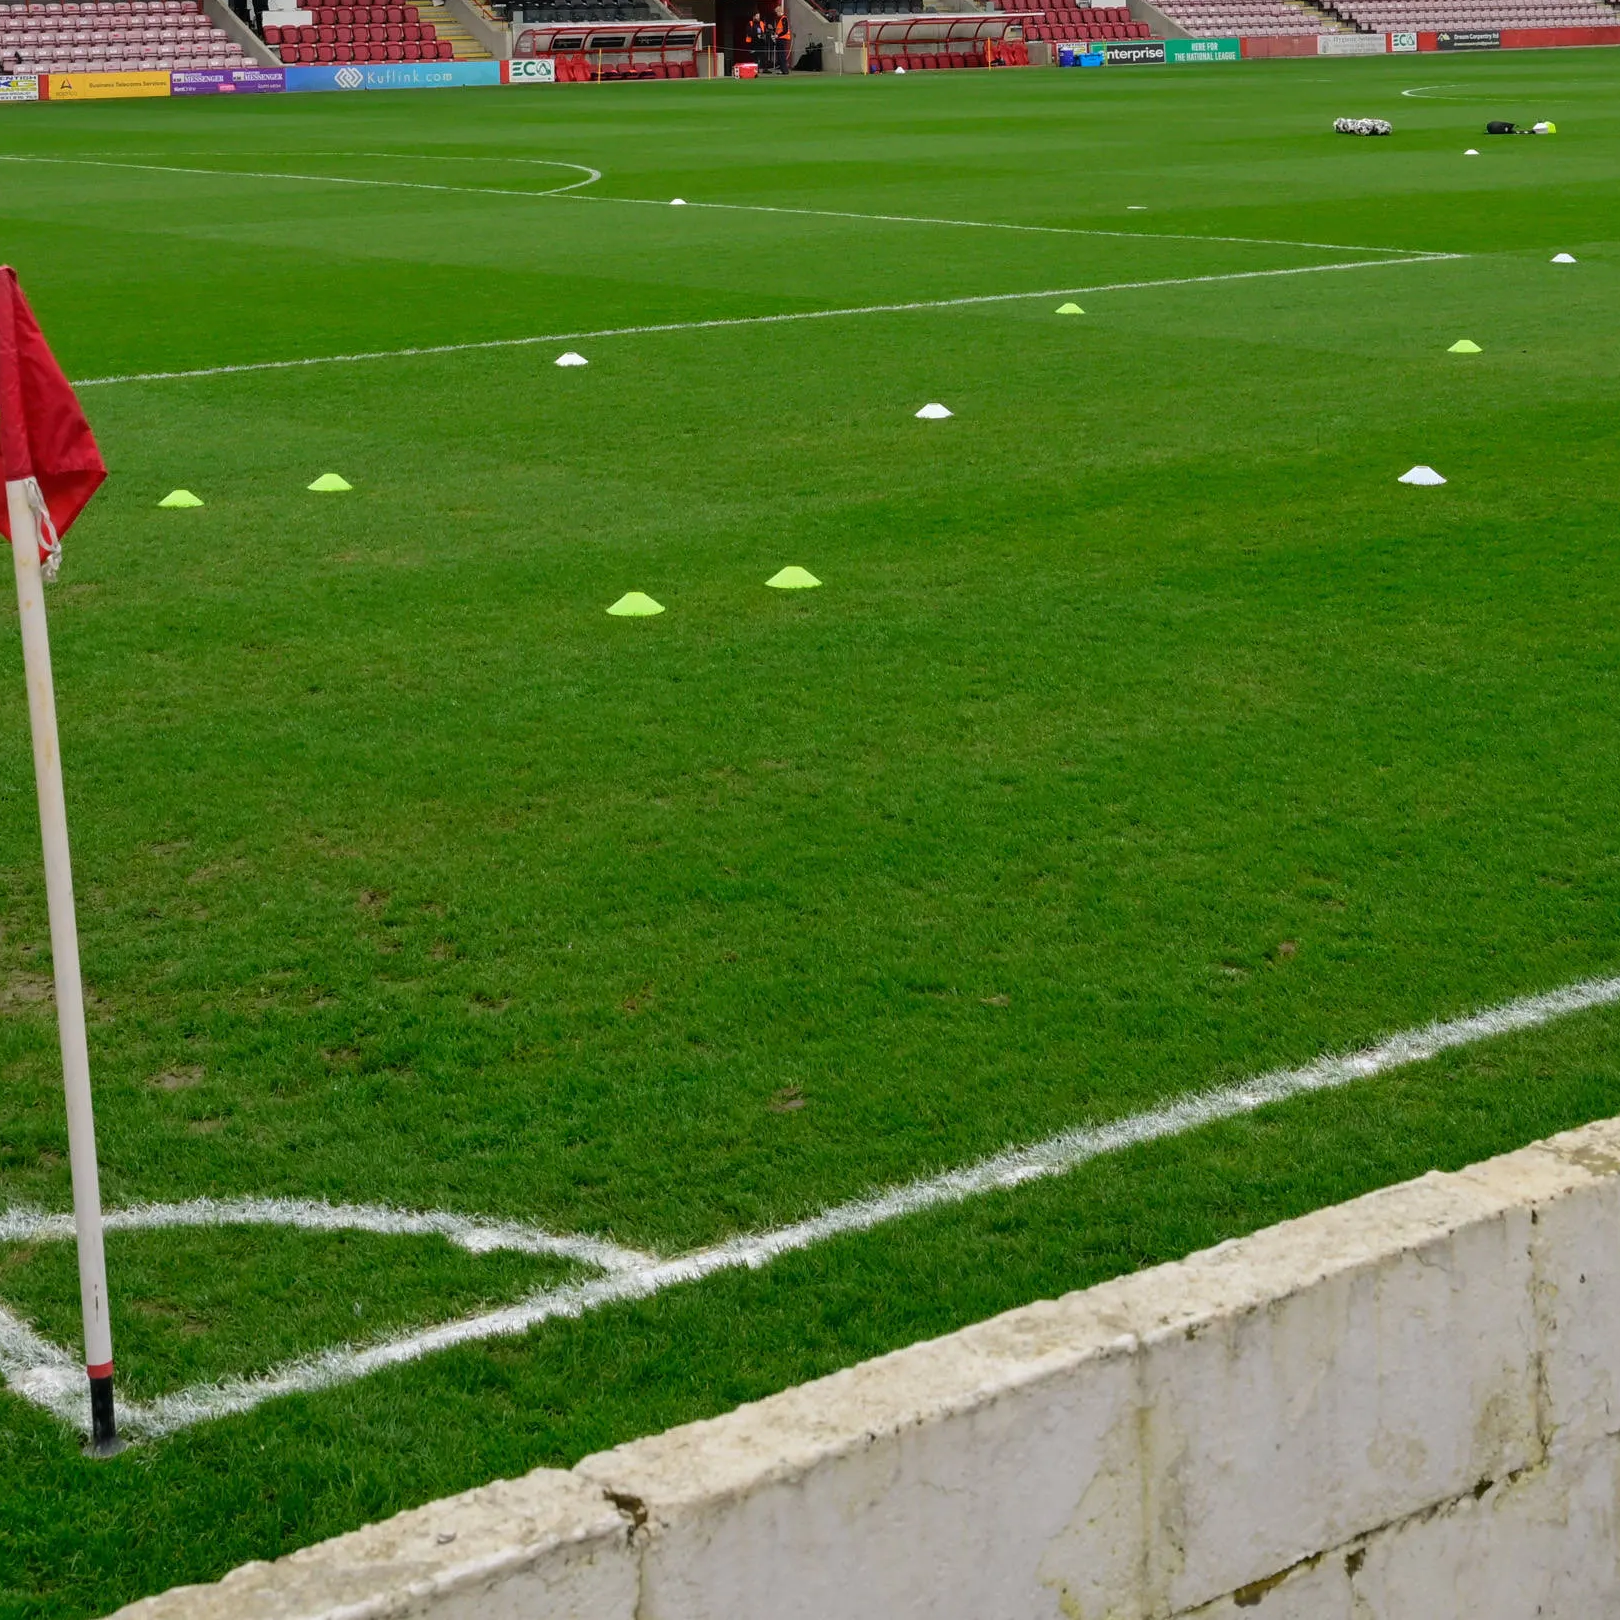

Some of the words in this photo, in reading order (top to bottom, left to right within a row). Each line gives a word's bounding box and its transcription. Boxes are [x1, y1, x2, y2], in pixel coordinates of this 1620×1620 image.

[1191, 42, 1206, 51] HERE
[1207, 42, 1219, 51] FOR
[1175, 52, 1185, 62] THE
[1185, 52, 1213, 61] NATIONAL
[1214, 51, 1236, 60] LEAGUE
[244, 73, 283, 81] MESSENGER
[89, 81, 115, 89] Business
